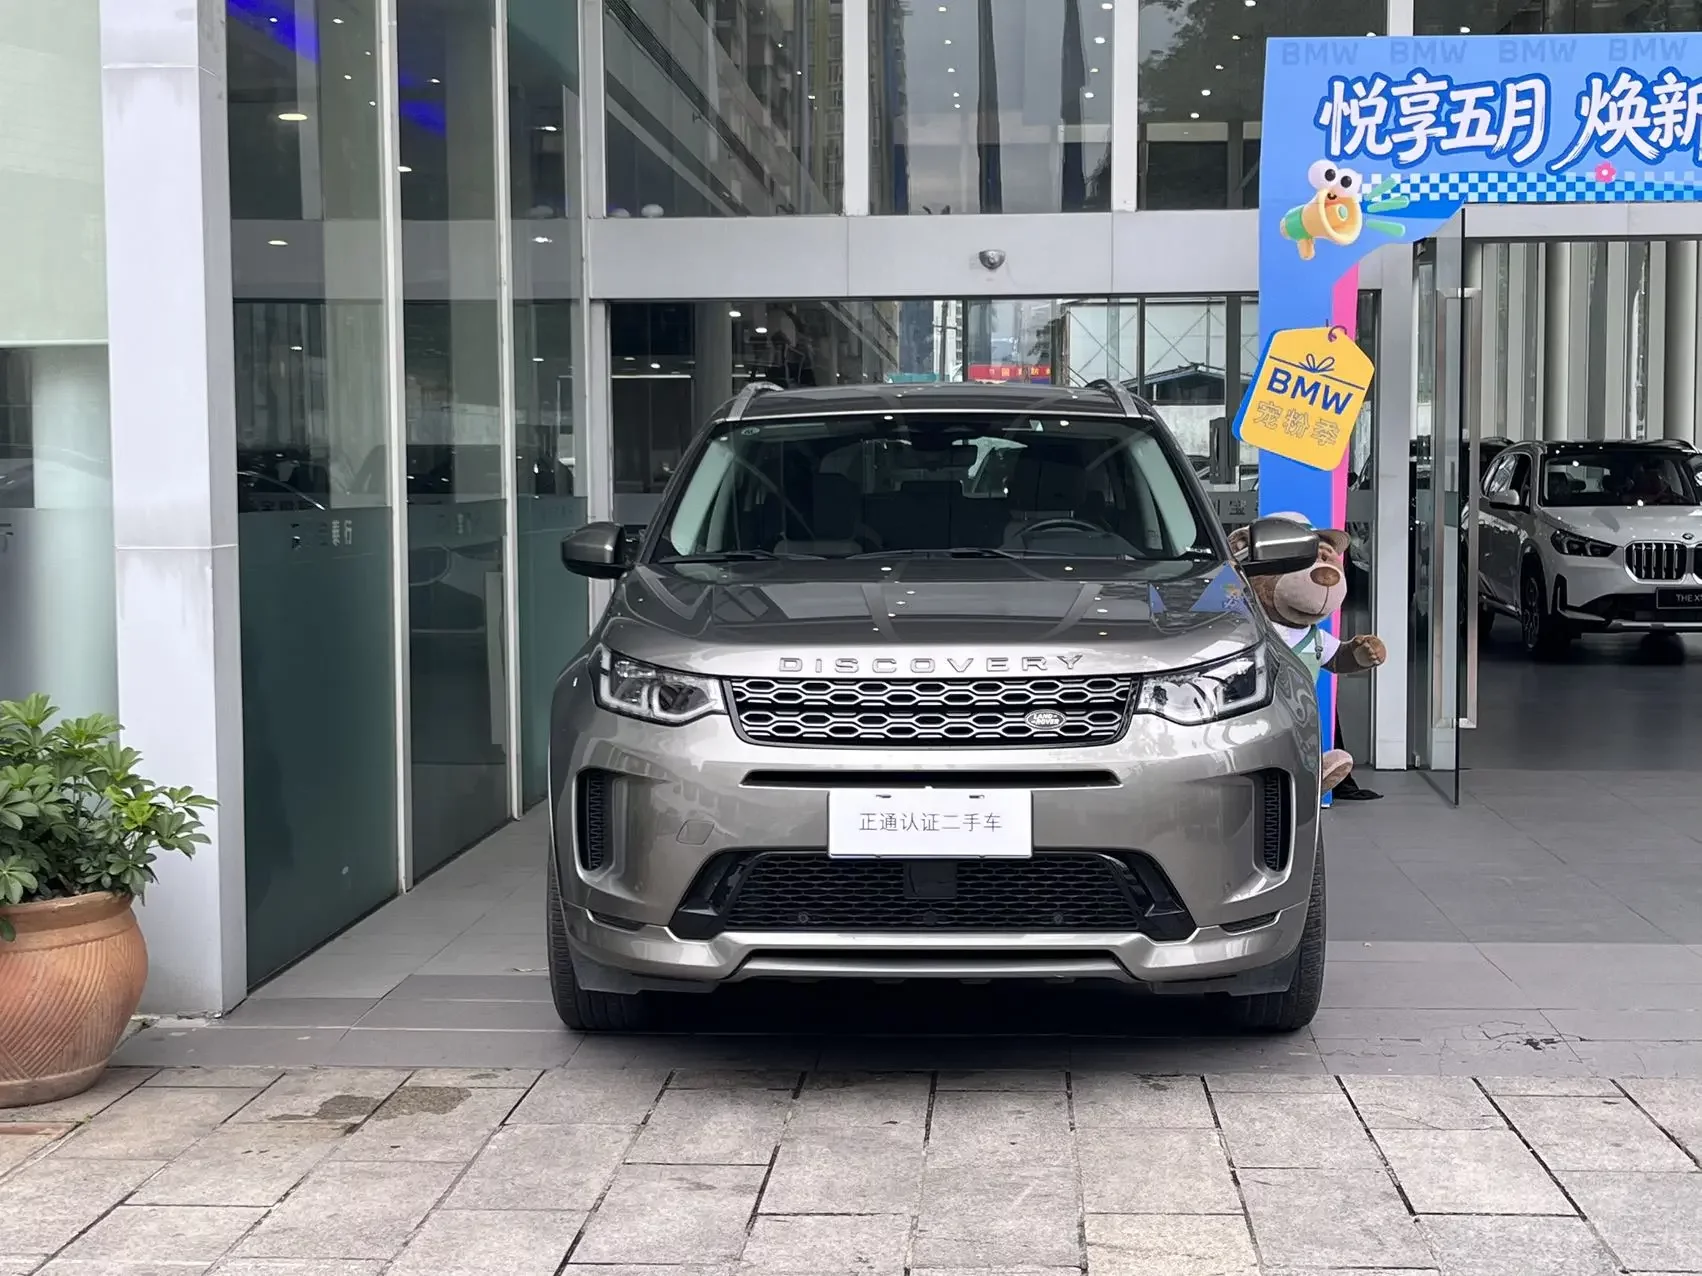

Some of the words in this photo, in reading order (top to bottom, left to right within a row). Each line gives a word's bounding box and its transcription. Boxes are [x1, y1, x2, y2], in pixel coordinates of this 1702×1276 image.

[1282, 42, 1359, 66] BMW
[1389, 40, 1467, 64] BMW
[1498, 38, 1578, 63] BMW
[1608, 37, 1688, 62] BMW
[1317, 73, 1544, 164] 悦享五月
[1550, 71, 1702, 171] 焕新
[1266, 366, 1354, 416] BMW
[1253, 400, 1341, 447] 宠粉季
[1675, 593, 1693, 602] THE
[778, 654, 1084, 674] DISCOVERY
[858, 811, 1003, 833] 正通认证二手车
